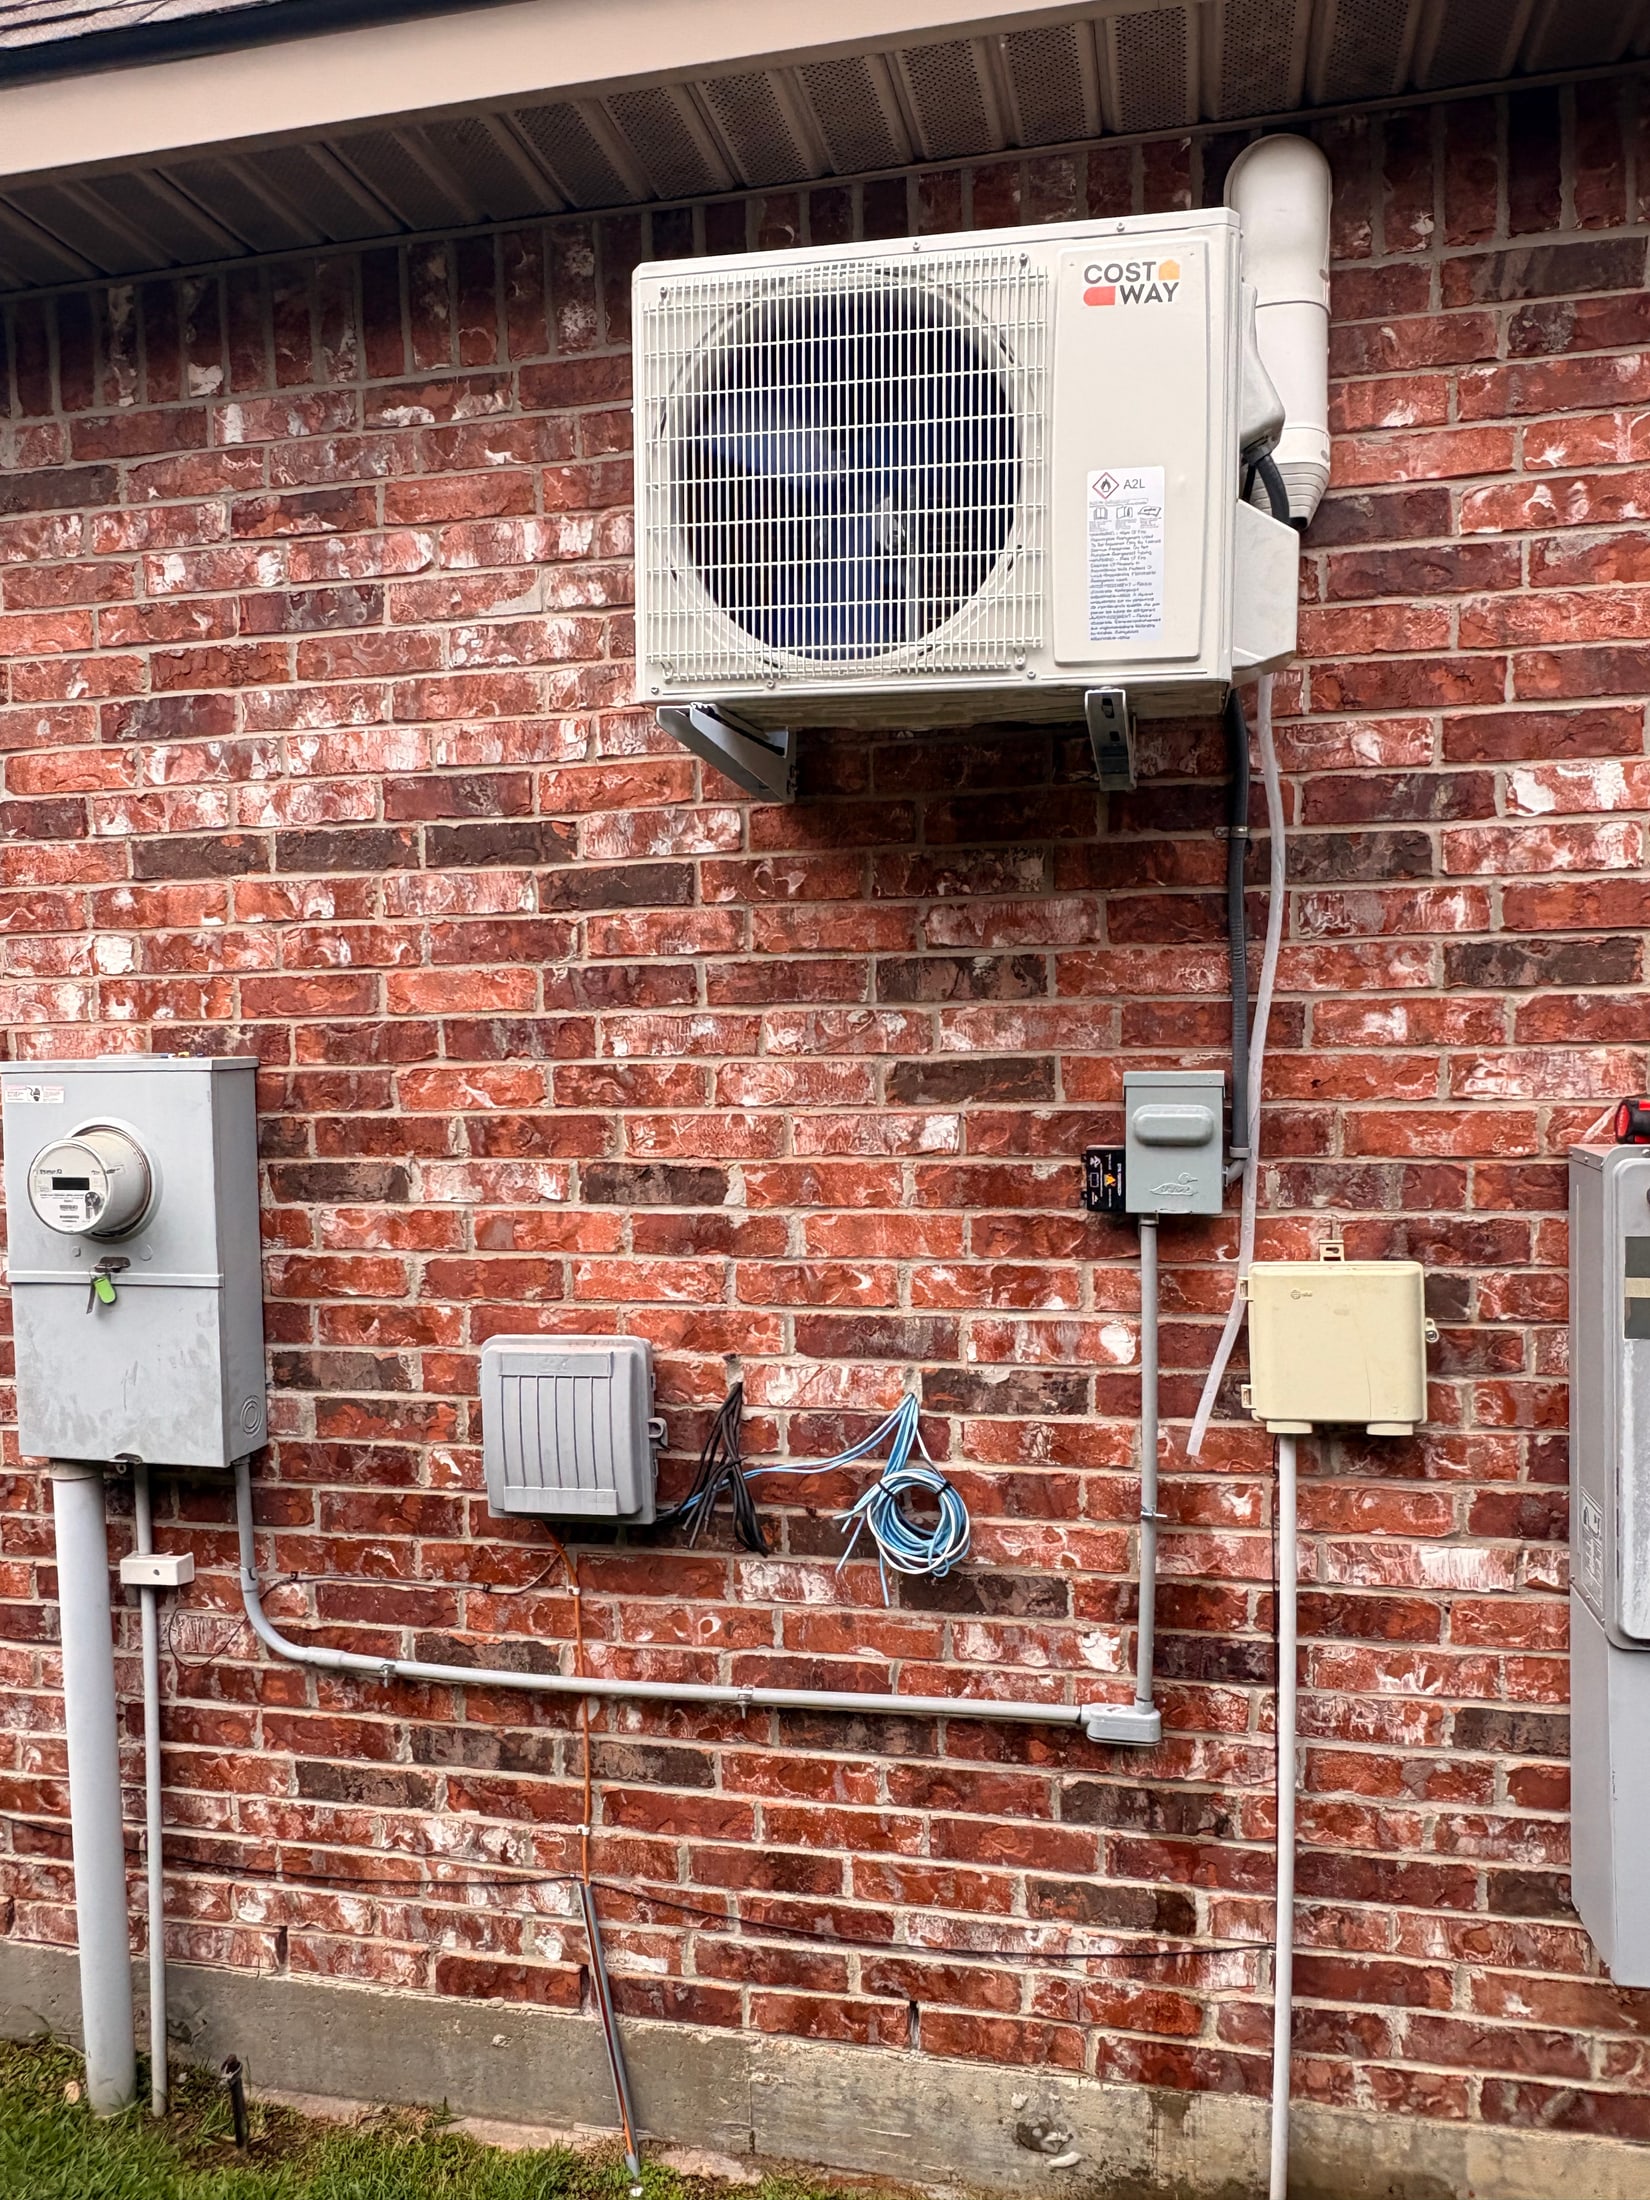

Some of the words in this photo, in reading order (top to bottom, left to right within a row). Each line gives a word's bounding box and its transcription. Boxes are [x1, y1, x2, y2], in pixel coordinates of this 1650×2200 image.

[1084, 261, 1157, 285] COST
[1119, 282, 1180, 305] WAY
[1123, 478, 1146, 490] A2L
